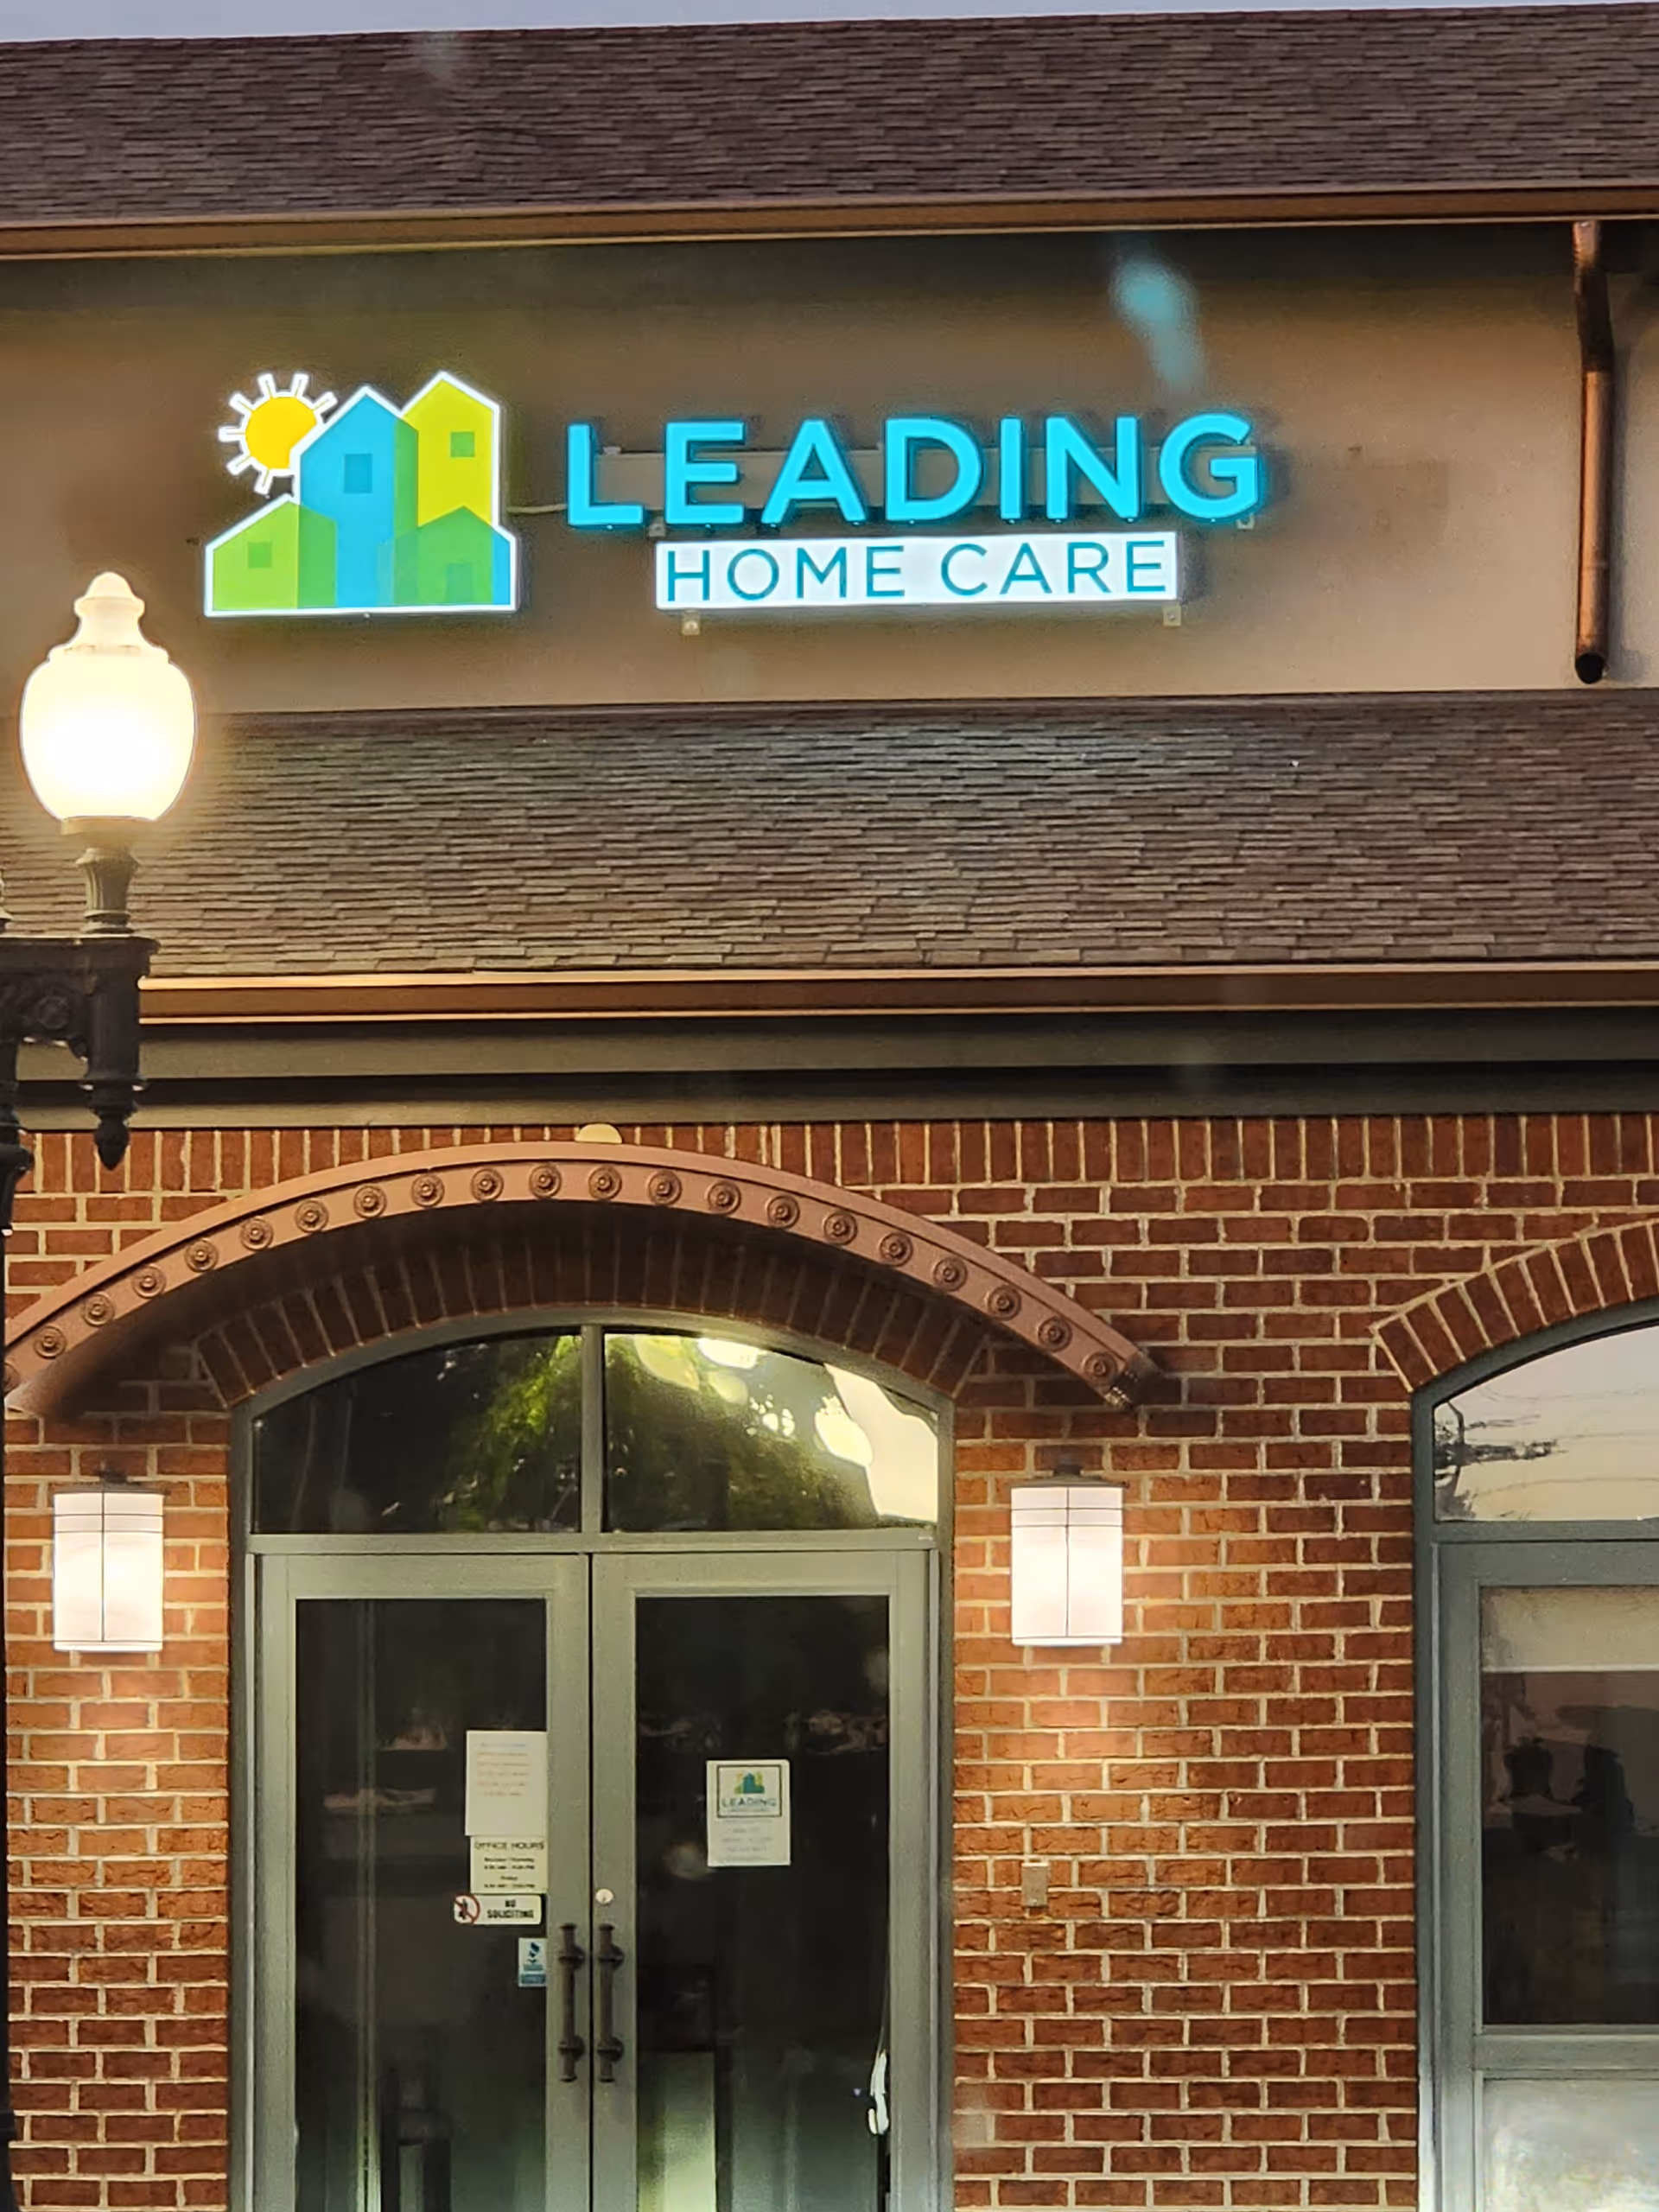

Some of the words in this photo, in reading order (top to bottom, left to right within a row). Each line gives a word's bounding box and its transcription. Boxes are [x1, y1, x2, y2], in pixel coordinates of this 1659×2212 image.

[566, 413, 1262, 527] LEADING
[666, 544, 906, 602] HOME
[940, 539, 1167, 596] CARE
[721, 1797, 777, 1808] LEADING
[511, 1841, 544, 1850] HOURS
